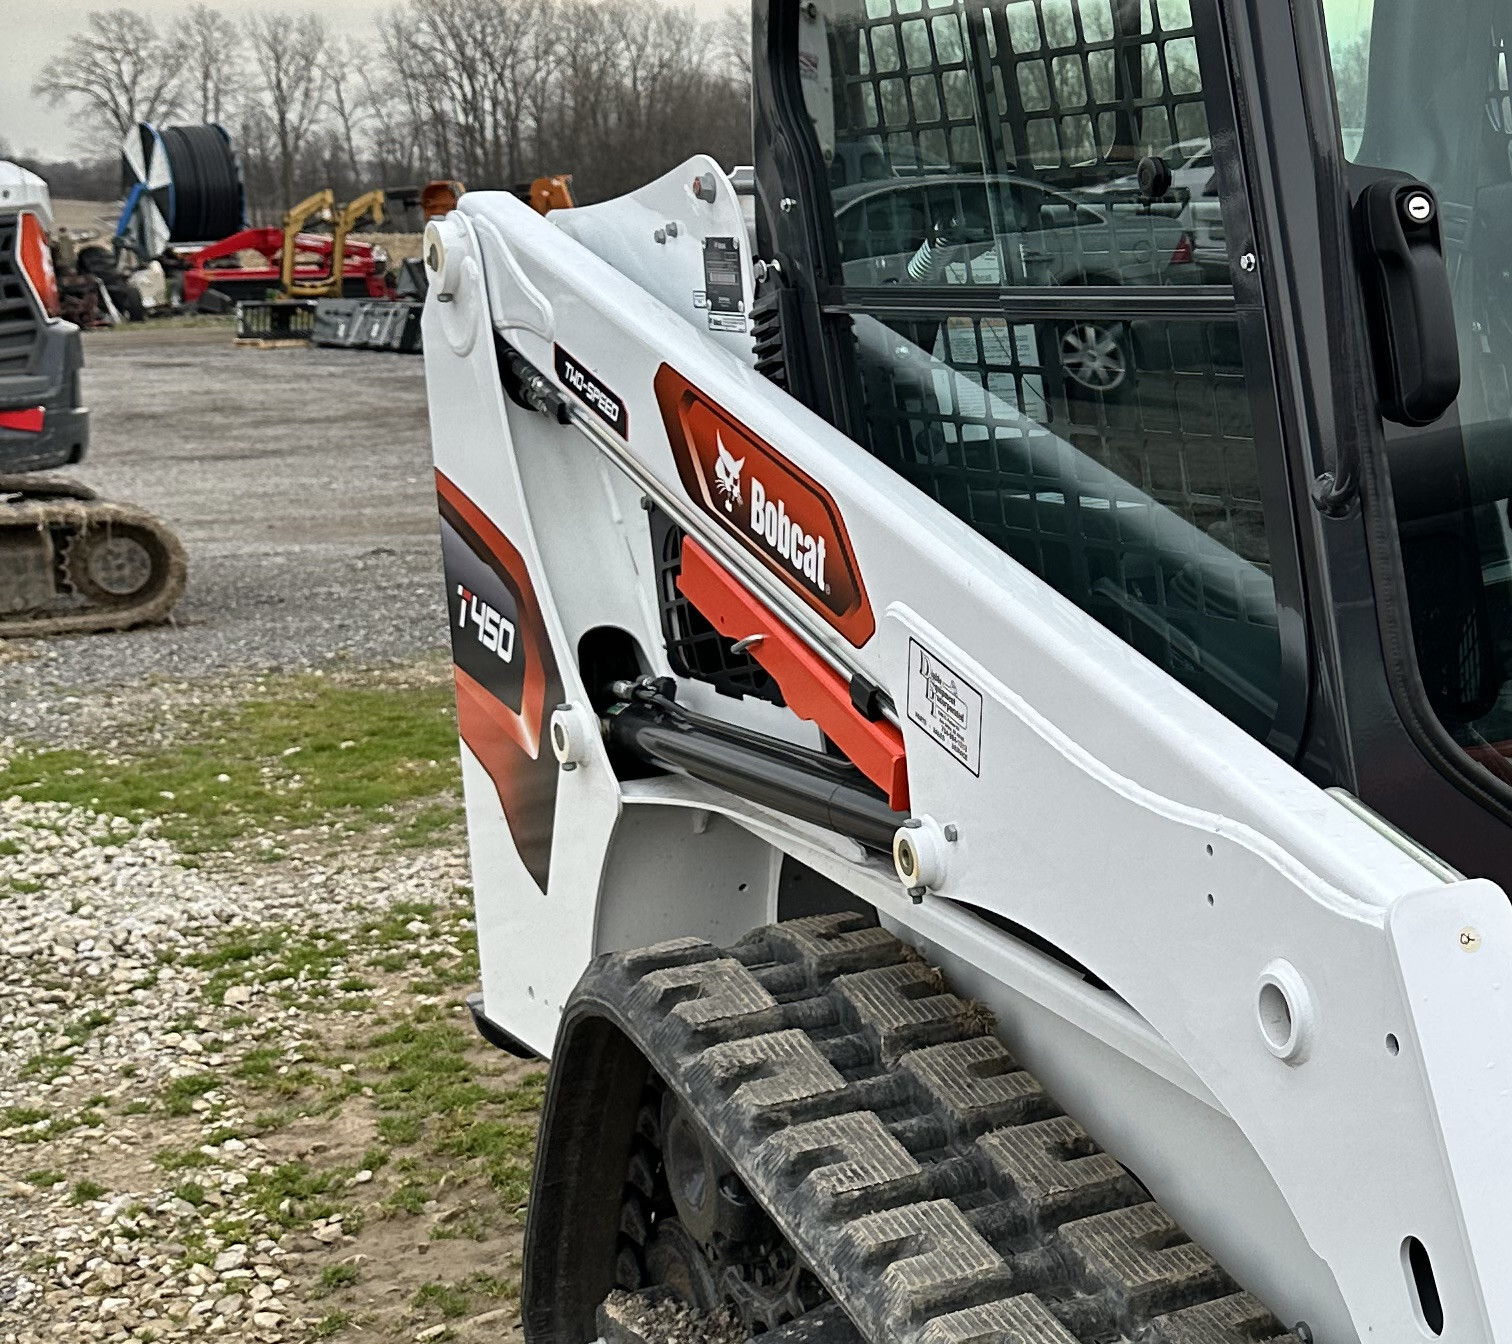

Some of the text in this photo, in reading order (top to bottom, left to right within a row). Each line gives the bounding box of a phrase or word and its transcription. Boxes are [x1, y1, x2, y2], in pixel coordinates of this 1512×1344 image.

[565, 361, 619, 422] TWO-SPEED
[751, 476, 826, 592] Bobcat
[457, 584, 515, 664] T450
